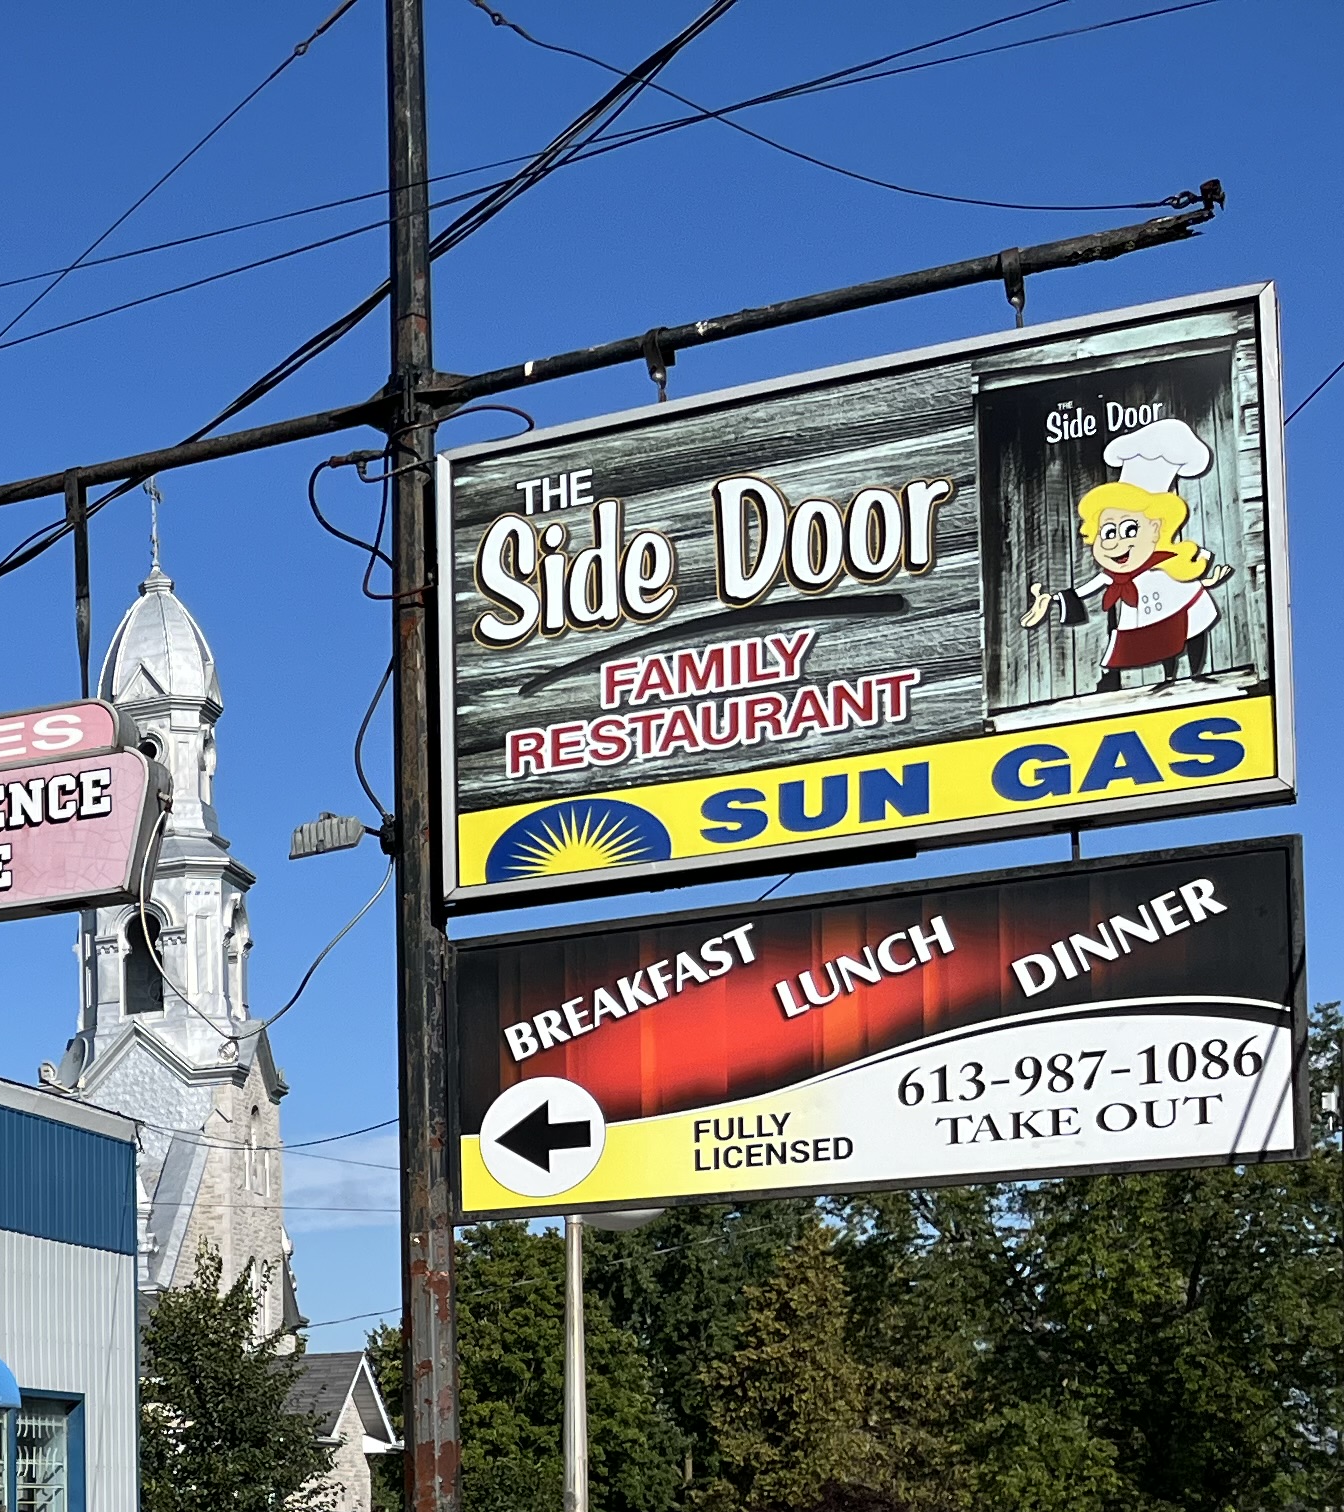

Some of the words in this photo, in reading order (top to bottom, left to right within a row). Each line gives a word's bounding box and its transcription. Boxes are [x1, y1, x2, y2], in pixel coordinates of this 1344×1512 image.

[1046, 407, 1097, 444] Side
[1106, 401, 1163, 432] Door
[1057, 401, 1074, 411] THE
[516, 468, 593, 516] THE
[473, 498, 676, 649] Side
[713, 474, 953, 608] Door
[600, 629, 815, 709] FAMILY
[506, 669, 920, 778] RESTAURANT
[700, 761, 931, 844] SUN
[991, 716, 1246, 801] GAS
[503, 922, 757, 1063] BREAKFAST
[775, 915, 956, 1019] LUNCH
[1011, 877, 1227, 998] DINNER
[898, 1033, 1264, 1107] 613-987-1086
[694, 1111, 791, 1144] FULLY
[935, 1107, 1081, 1147] TAKE
[1095, 1093, 1223, 1136] OUT
[694, 1136, 854, 1172] LICENSED
